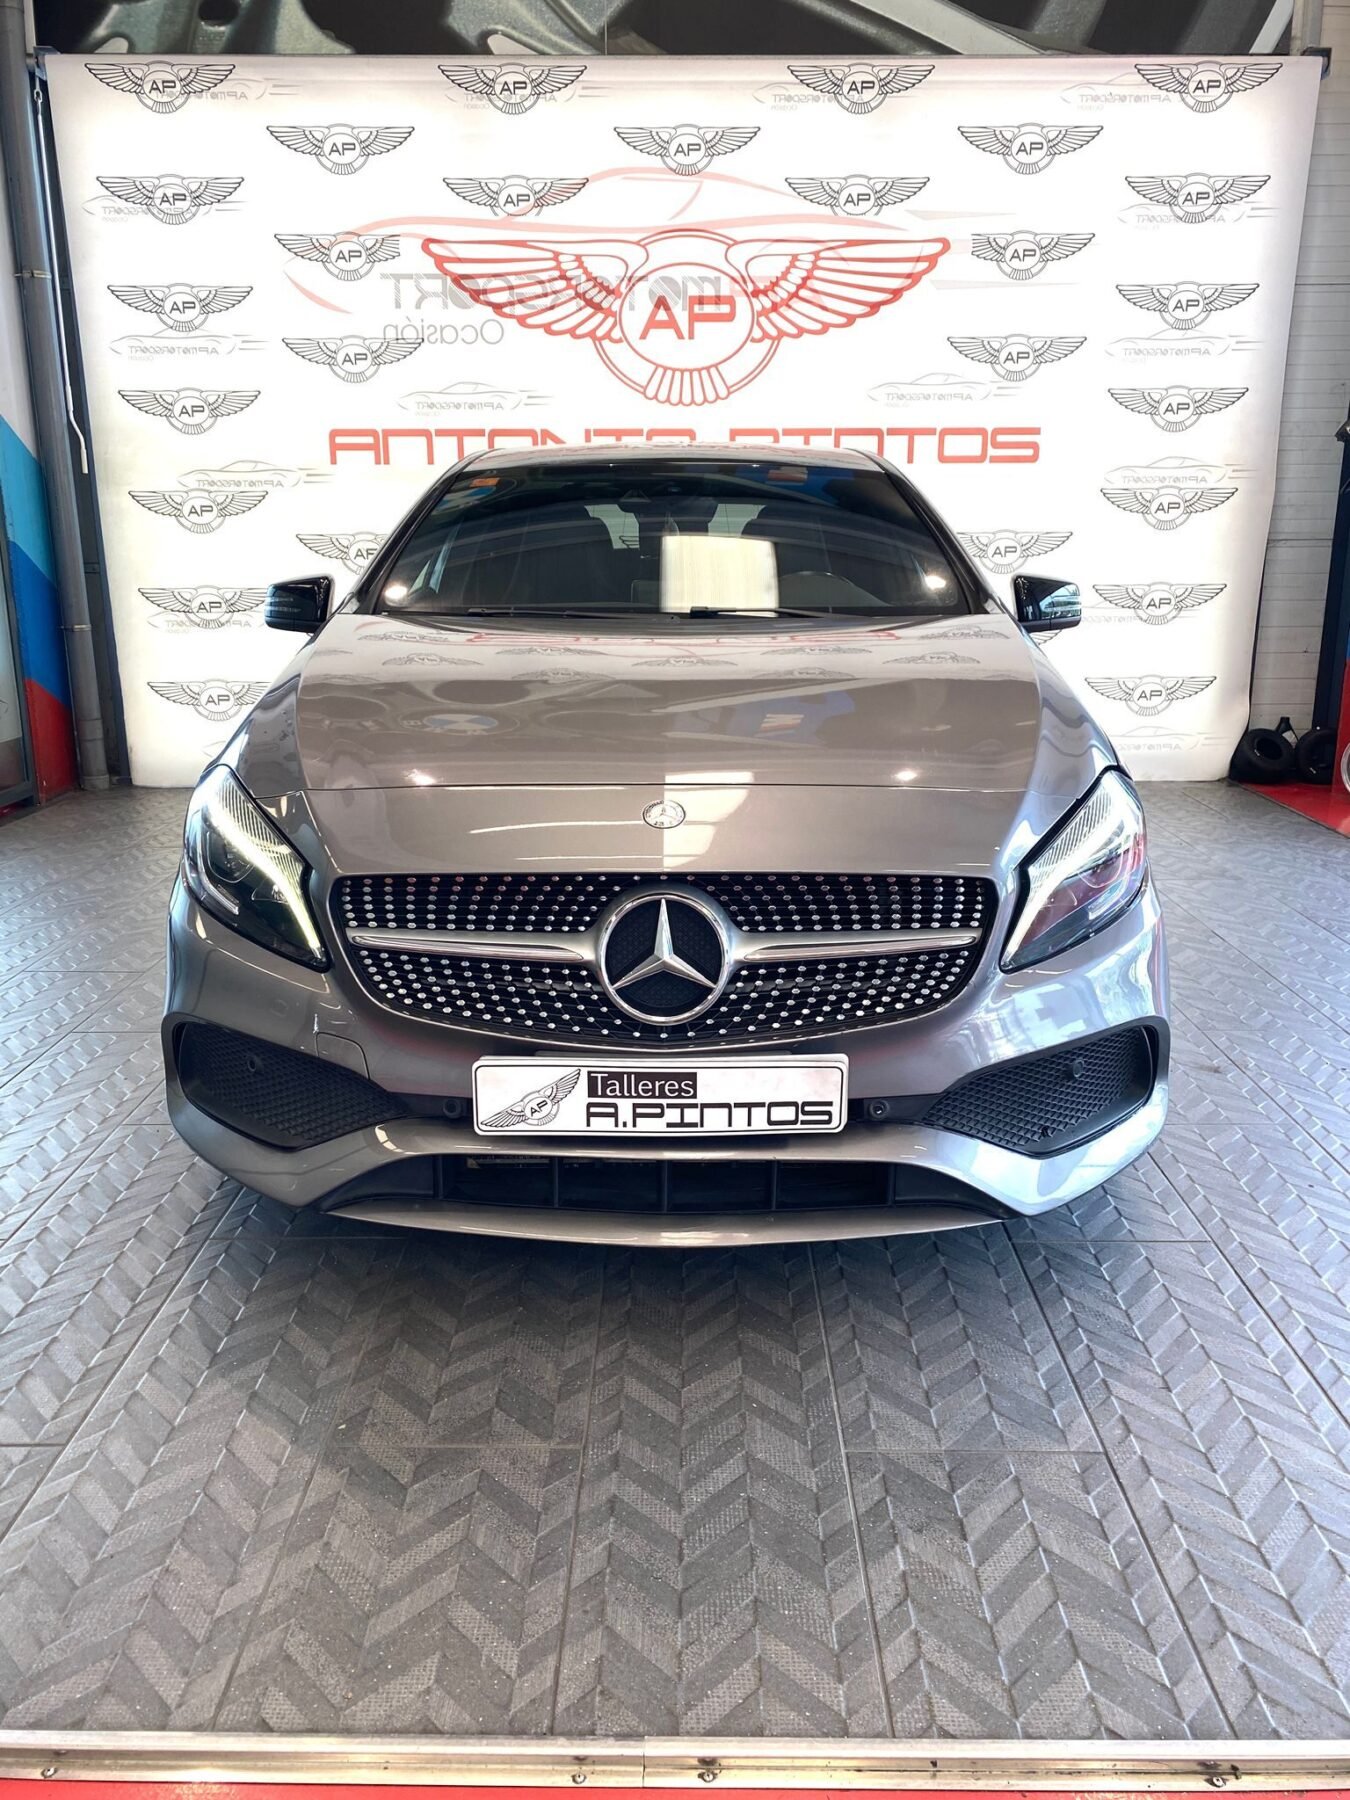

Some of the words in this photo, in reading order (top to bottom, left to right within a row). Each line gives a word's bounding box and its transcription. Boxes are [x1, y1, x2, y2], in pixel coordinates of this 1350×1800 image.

[149, 80, 176, 94] AP
[500, 81, 527, 94] AP
[847, 81, 875, 94] AP
[1193, 80, 1221, 93] AP
[329, 143, 356, 155] AP
[674, 144, 701, 156] AP
[1016, 142, 1043, 155] AP
[160, 193, 186, 205] AP
[504, 194, 530, 206] AP
[844, 194, 870, 206] AP
[1182, 192, 1210, 204] AP
[335, 250, 362, 262] AP
[1010, 249, 1036, 261] AP
[170, 302, 195, 313] AP
[1173, 300, 1199, 312] AP
[639, 295, 736, 340] AP
[342, 353, 367, 365] AP
[1004, 352, 1029, 363] AP
[179, 405, 204, 417] AP
[1164, 403, 1190, 414] AP
[188, 505, 213, 516] AP
[1155, 502, 1180, 513] AP
[992, 546, 1017, 557] AP
[197, 602, 221, 613] AP
[1146, 597, 1171, 609] AP
[206, 694, 230, 705] AP
[1138, 690, 1162, 701] AP
[591, 1073, 695, 1098] Talleres
[530, 1100, 549, 1118] AP
[586, 1101, 834, 1129] A.PINTOS
